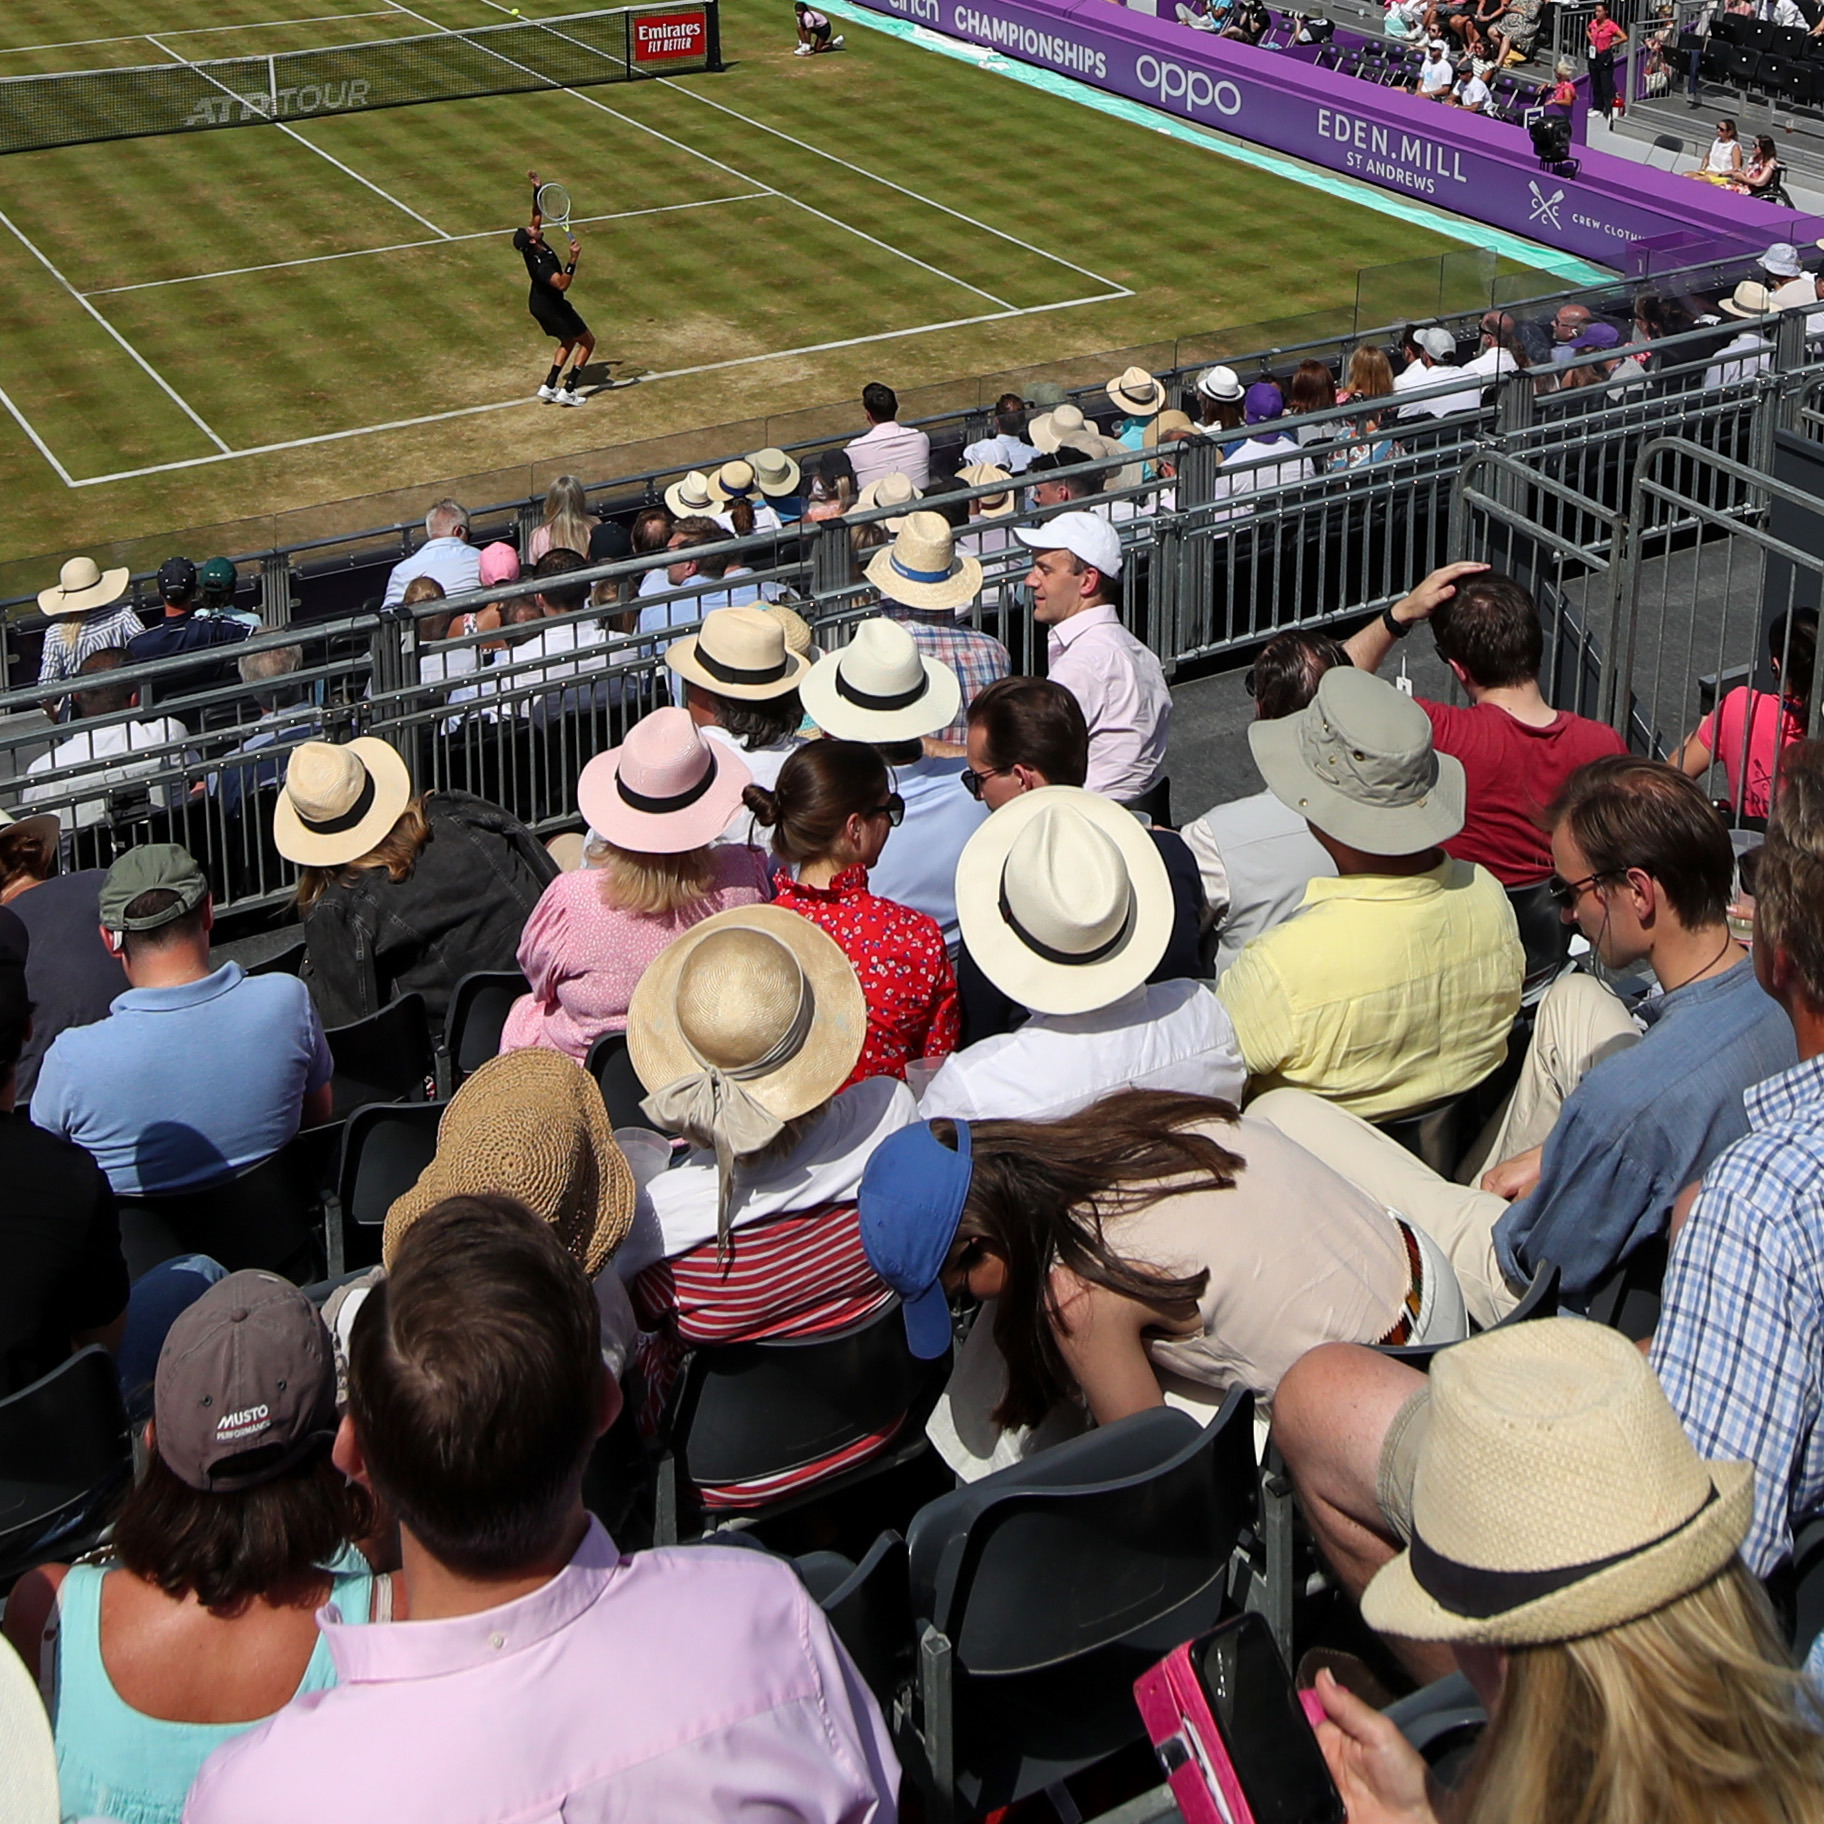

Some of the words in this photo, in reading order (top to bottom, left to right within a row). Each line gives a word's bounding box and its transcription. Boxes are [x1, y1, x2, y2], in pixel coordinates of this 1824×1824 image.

[638, 22, 701, 41] Emirates
[647, 40, 662, 54] FLY
[663, 37, 692, 52] BETTER
[955, 4, 1107, 80] CHAMPIONSHIPS
[277, 78, 372, 114] TOUR
[1135, 54, 1242, 117] oppo
[1317, 108, 1468, 184] EDEN.MILL
[1366, 159, 1436, 195] ANDREWS
[1572, 213, 1601, 230] CREW
[217, 1404, 269, 1429] MUSTO
[217, 1419, 271, 1440] PERFORMANCE
